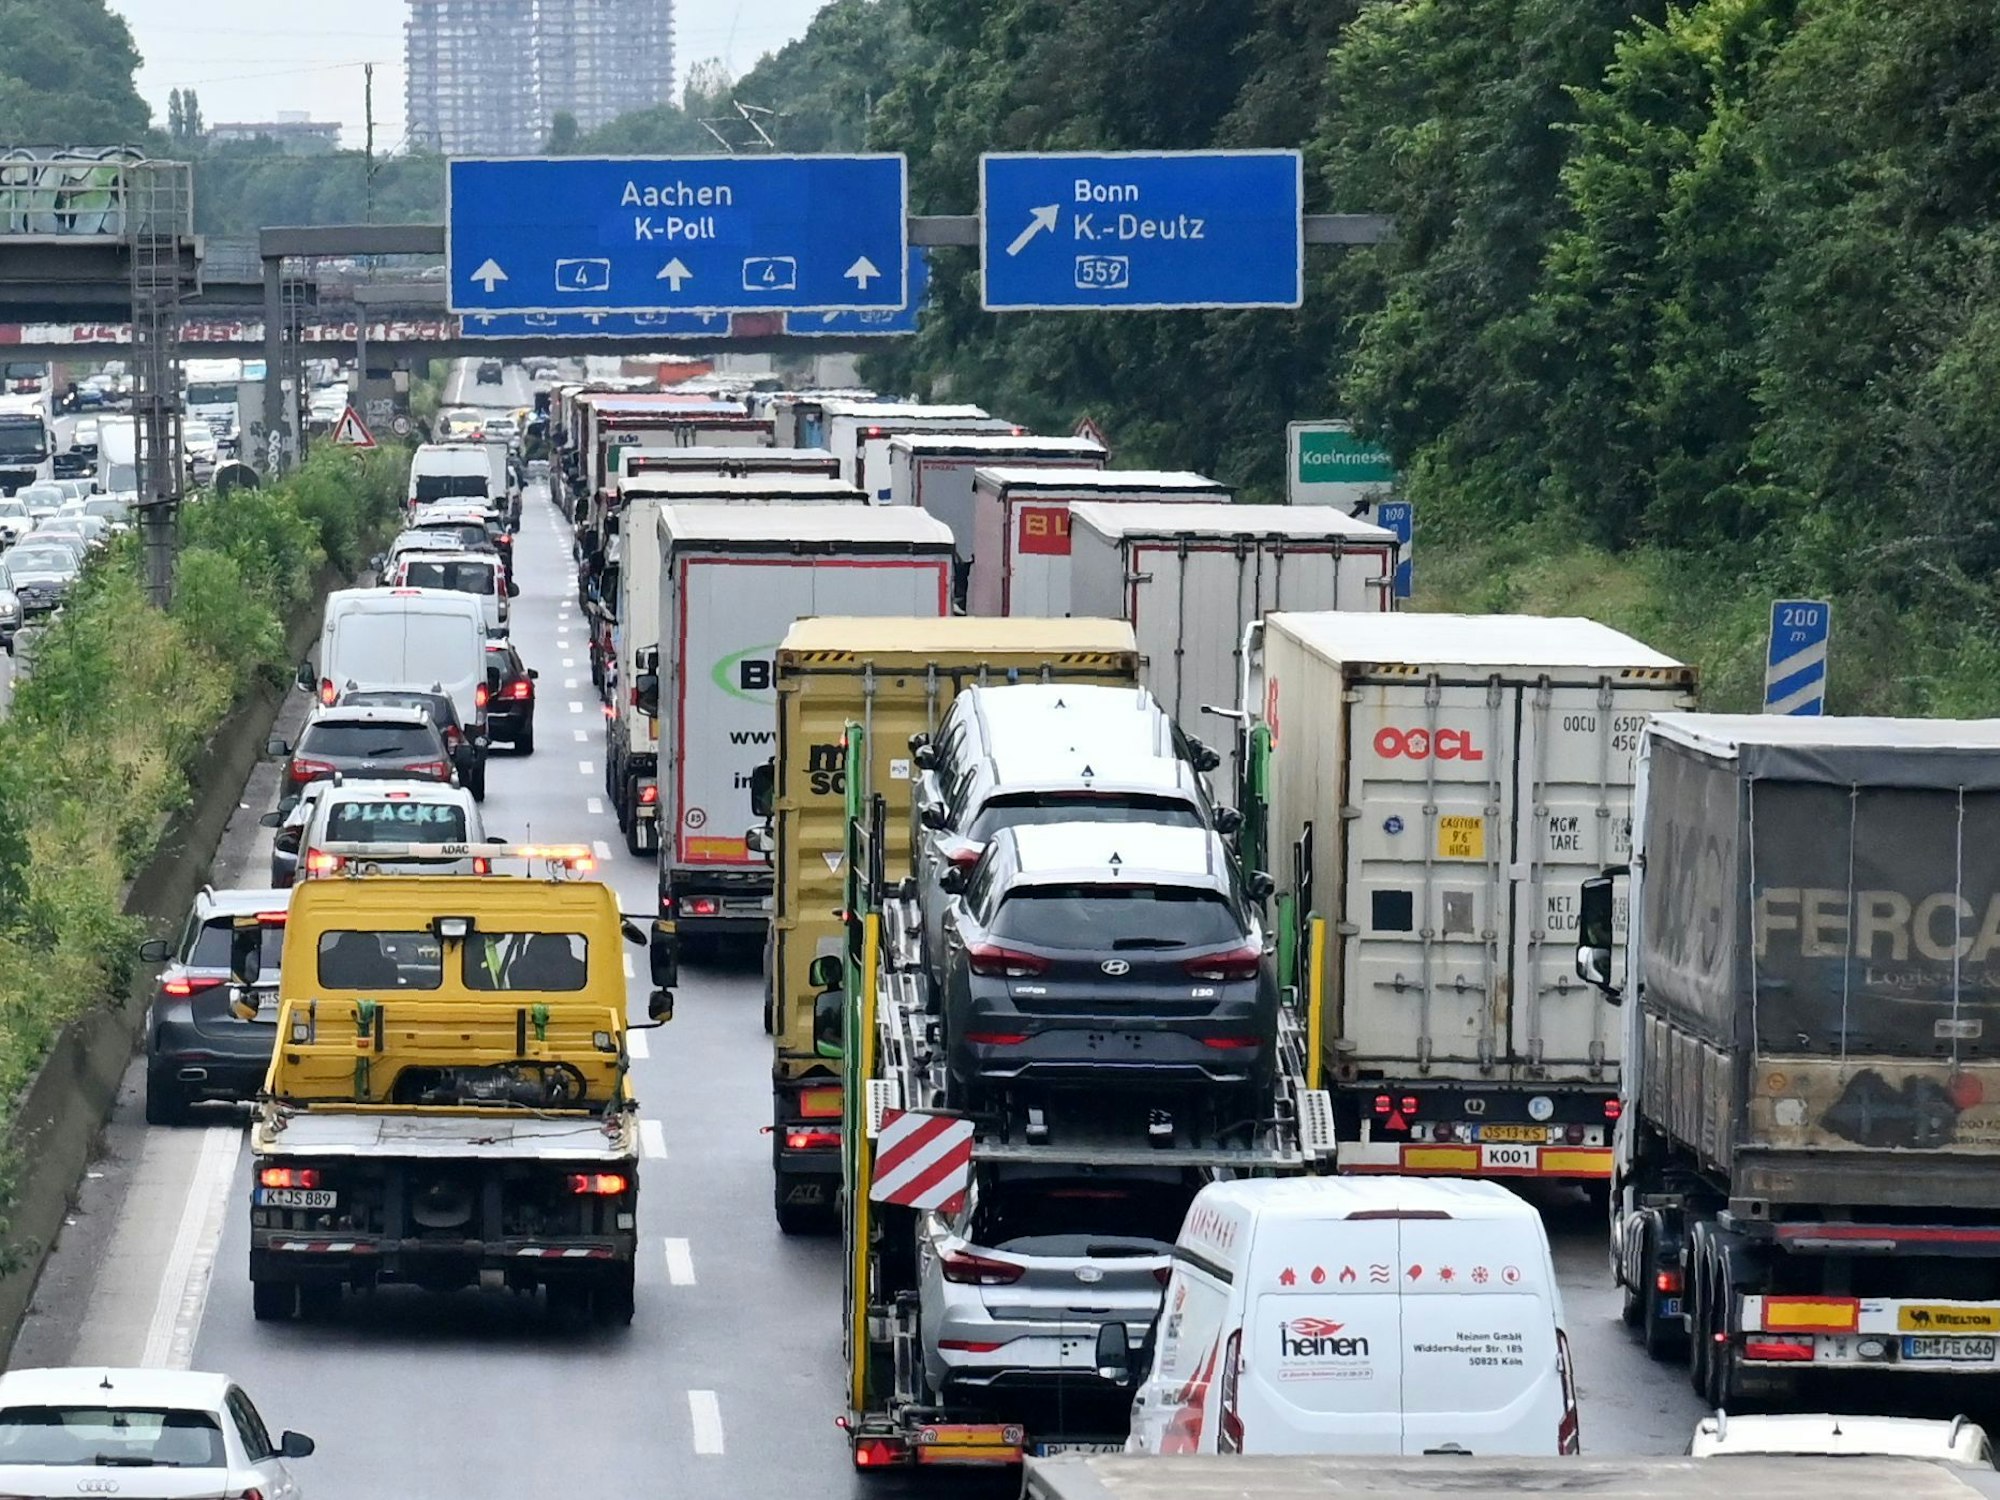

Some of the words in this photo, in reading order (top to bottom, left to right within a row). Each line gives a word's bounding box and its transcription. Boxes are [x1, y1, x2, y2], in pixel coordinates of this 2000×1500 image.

[620, 180, 732, 207] Aachen
[1074, 179, 1139, 203] Bonn
[634, 216, 716, 241] K-Poll
[1074, 213, 1205, 241] K.-Deutz
[574, 265, 588, 285] 4
[761, 264, 776, 284] 4
[1082, 261, 1121, 282] 559
[1385, 507, 1404, 521] 100
[1782, 608, 1819, 627] 200
[1790, 631, 1807, 642] m
[1373, 726, 1484, 761] OOCL
[342, 802, 452, 823] PLACKE
[440, 845, 470, 856] ADAC
[1449, 844, 1471, 856] HIGH
[1488, 1149, 1530, 1164] K001
[305, 1191, 331, 1206] 889
[1935, 1314, 1991, 1325] WIELTON
[1279, 1321, 1369, 1357] heinen
